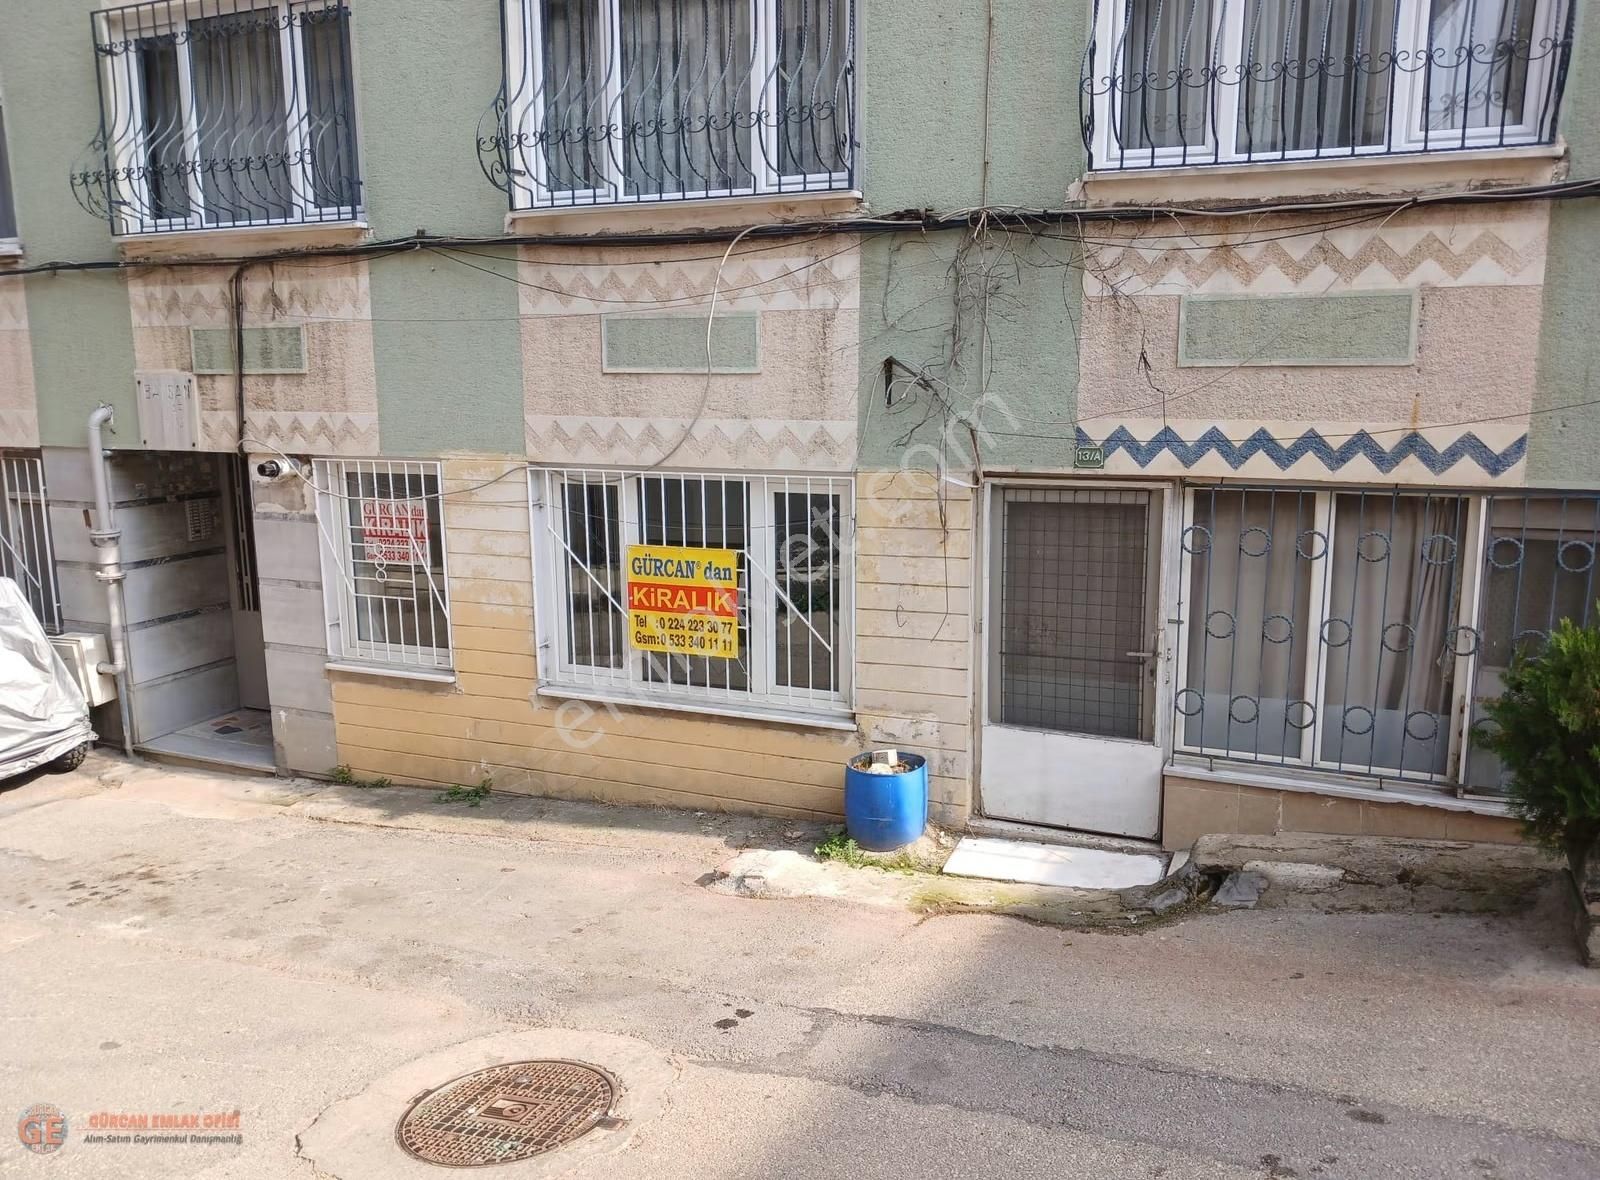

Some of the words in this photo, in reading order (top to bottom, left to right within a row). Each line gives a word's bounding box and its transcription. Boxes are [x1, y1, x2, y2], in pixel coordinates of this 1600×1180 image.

[1078, 451, 1101, 461] 13/A
[703, 561, 733, 581] dan
[634, 614, 647, 628] Tel
[668, 618, 686, 631] 224
[687, 619, 704, 633] 223
[707, 620, 719, 634] 30
[720, 621, 733, 635] 77
[669, 633, 686, 647] 533
[688, 635, 706, 649] 340
[707, 637, 719, 651] 11
[722, 639, 733, 652] 11
